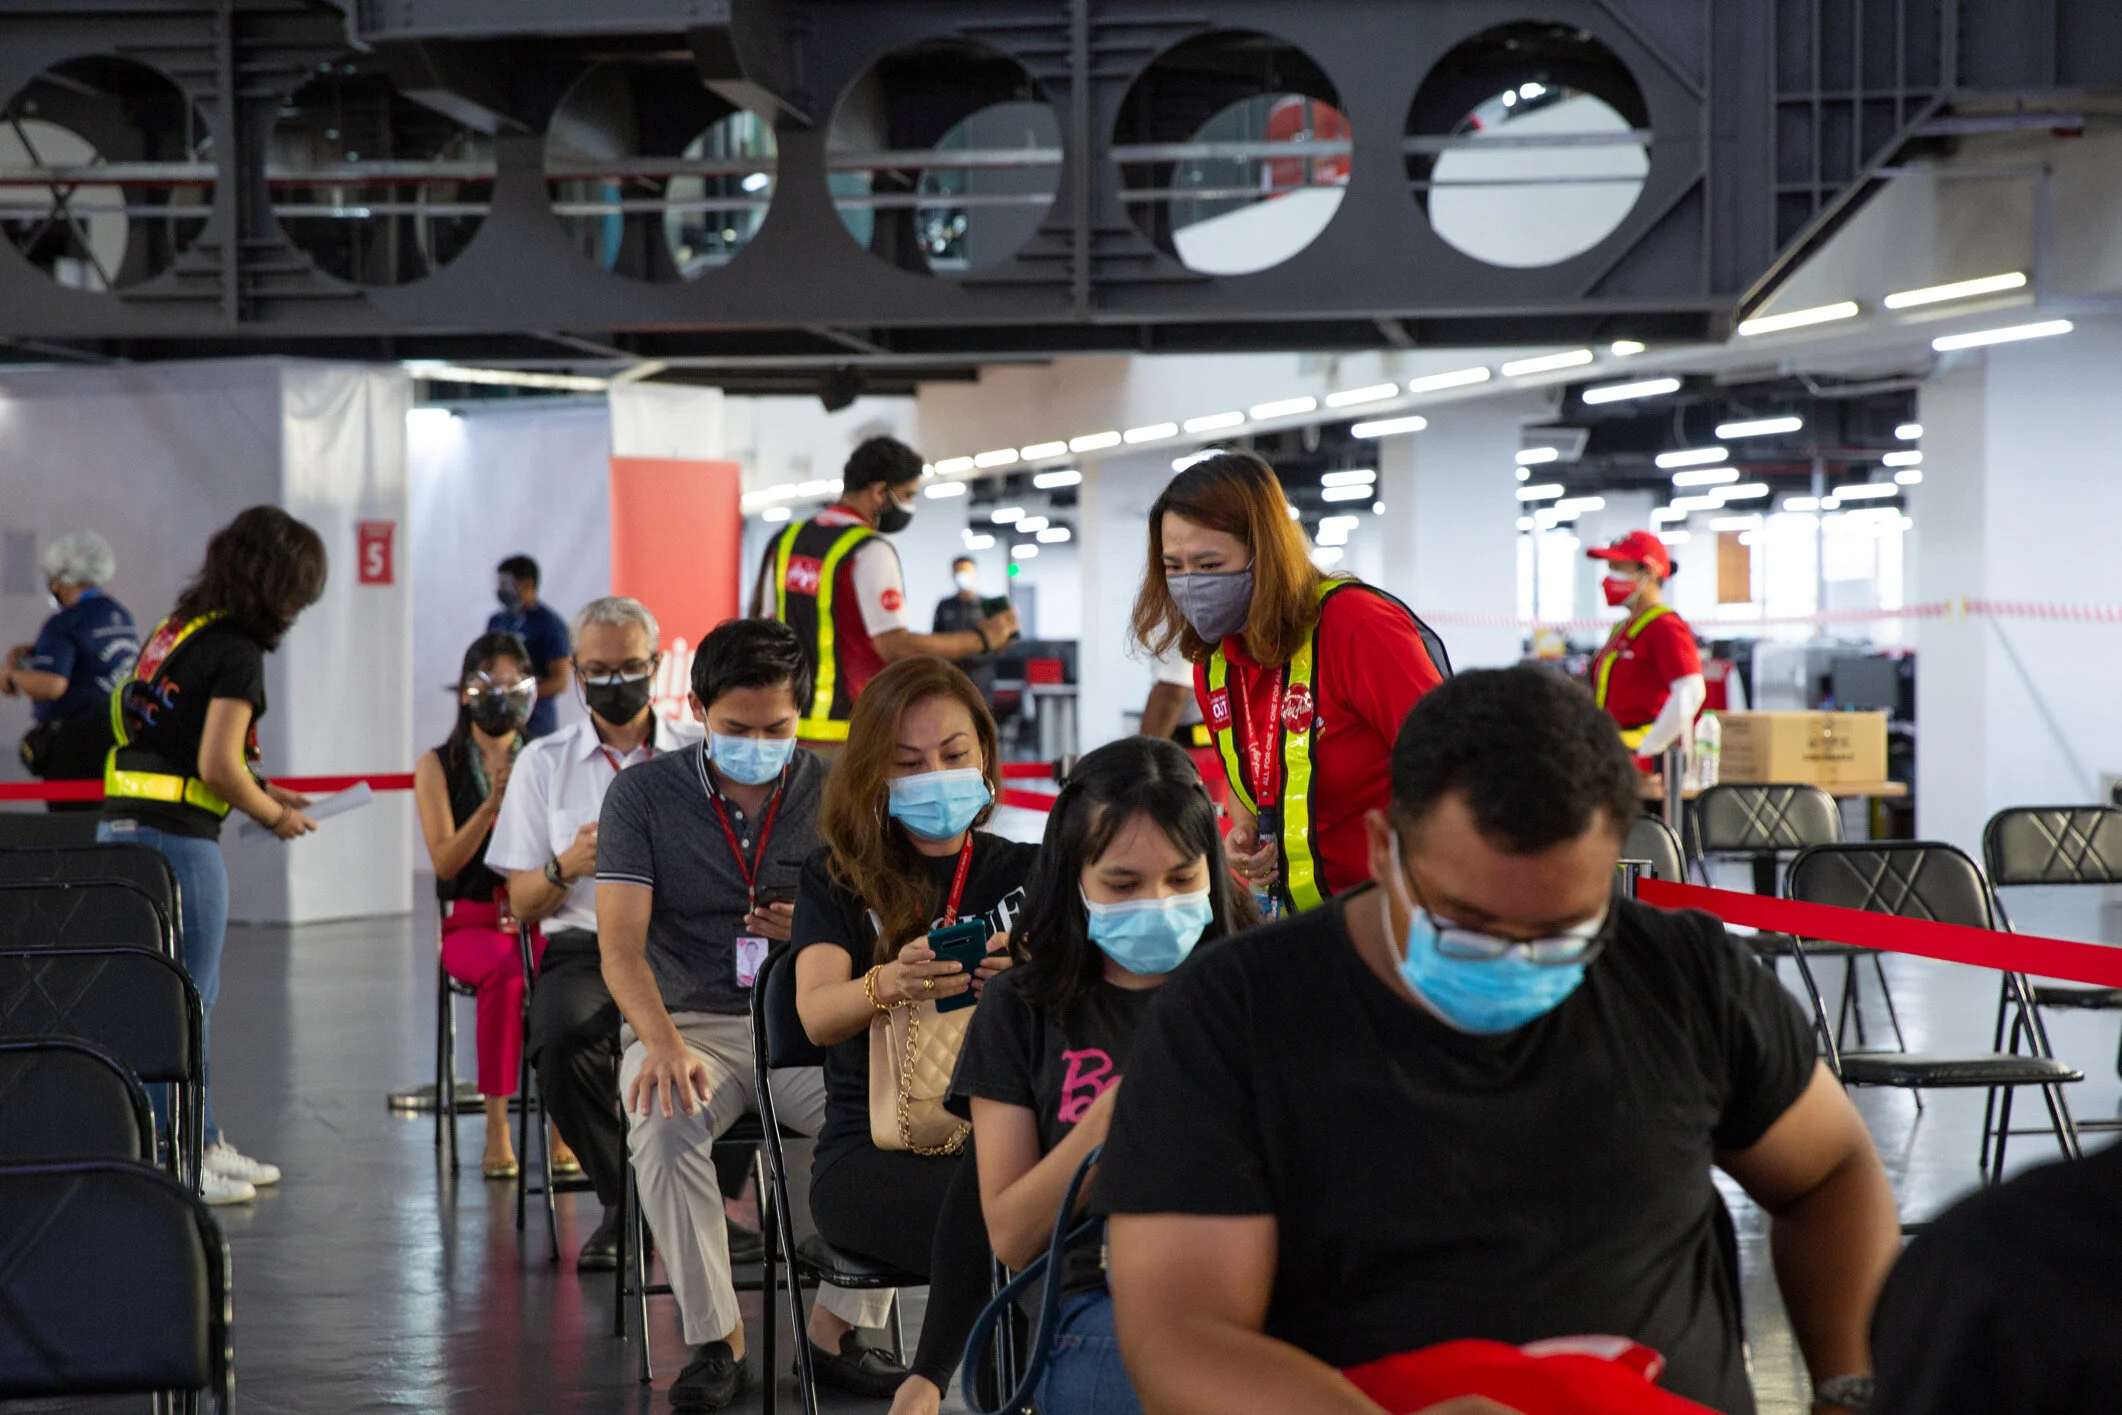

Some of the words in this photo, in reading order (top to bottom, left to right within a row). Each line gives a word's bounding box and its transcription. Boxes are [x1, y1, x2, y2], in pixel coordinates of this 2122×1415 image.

[366, 541, 385, 577] 5
[1272, 684, 1280, 702] FOR
[1270, 703, 1278, 722] ONE
[1266, 732, 1274, 751] ONE
